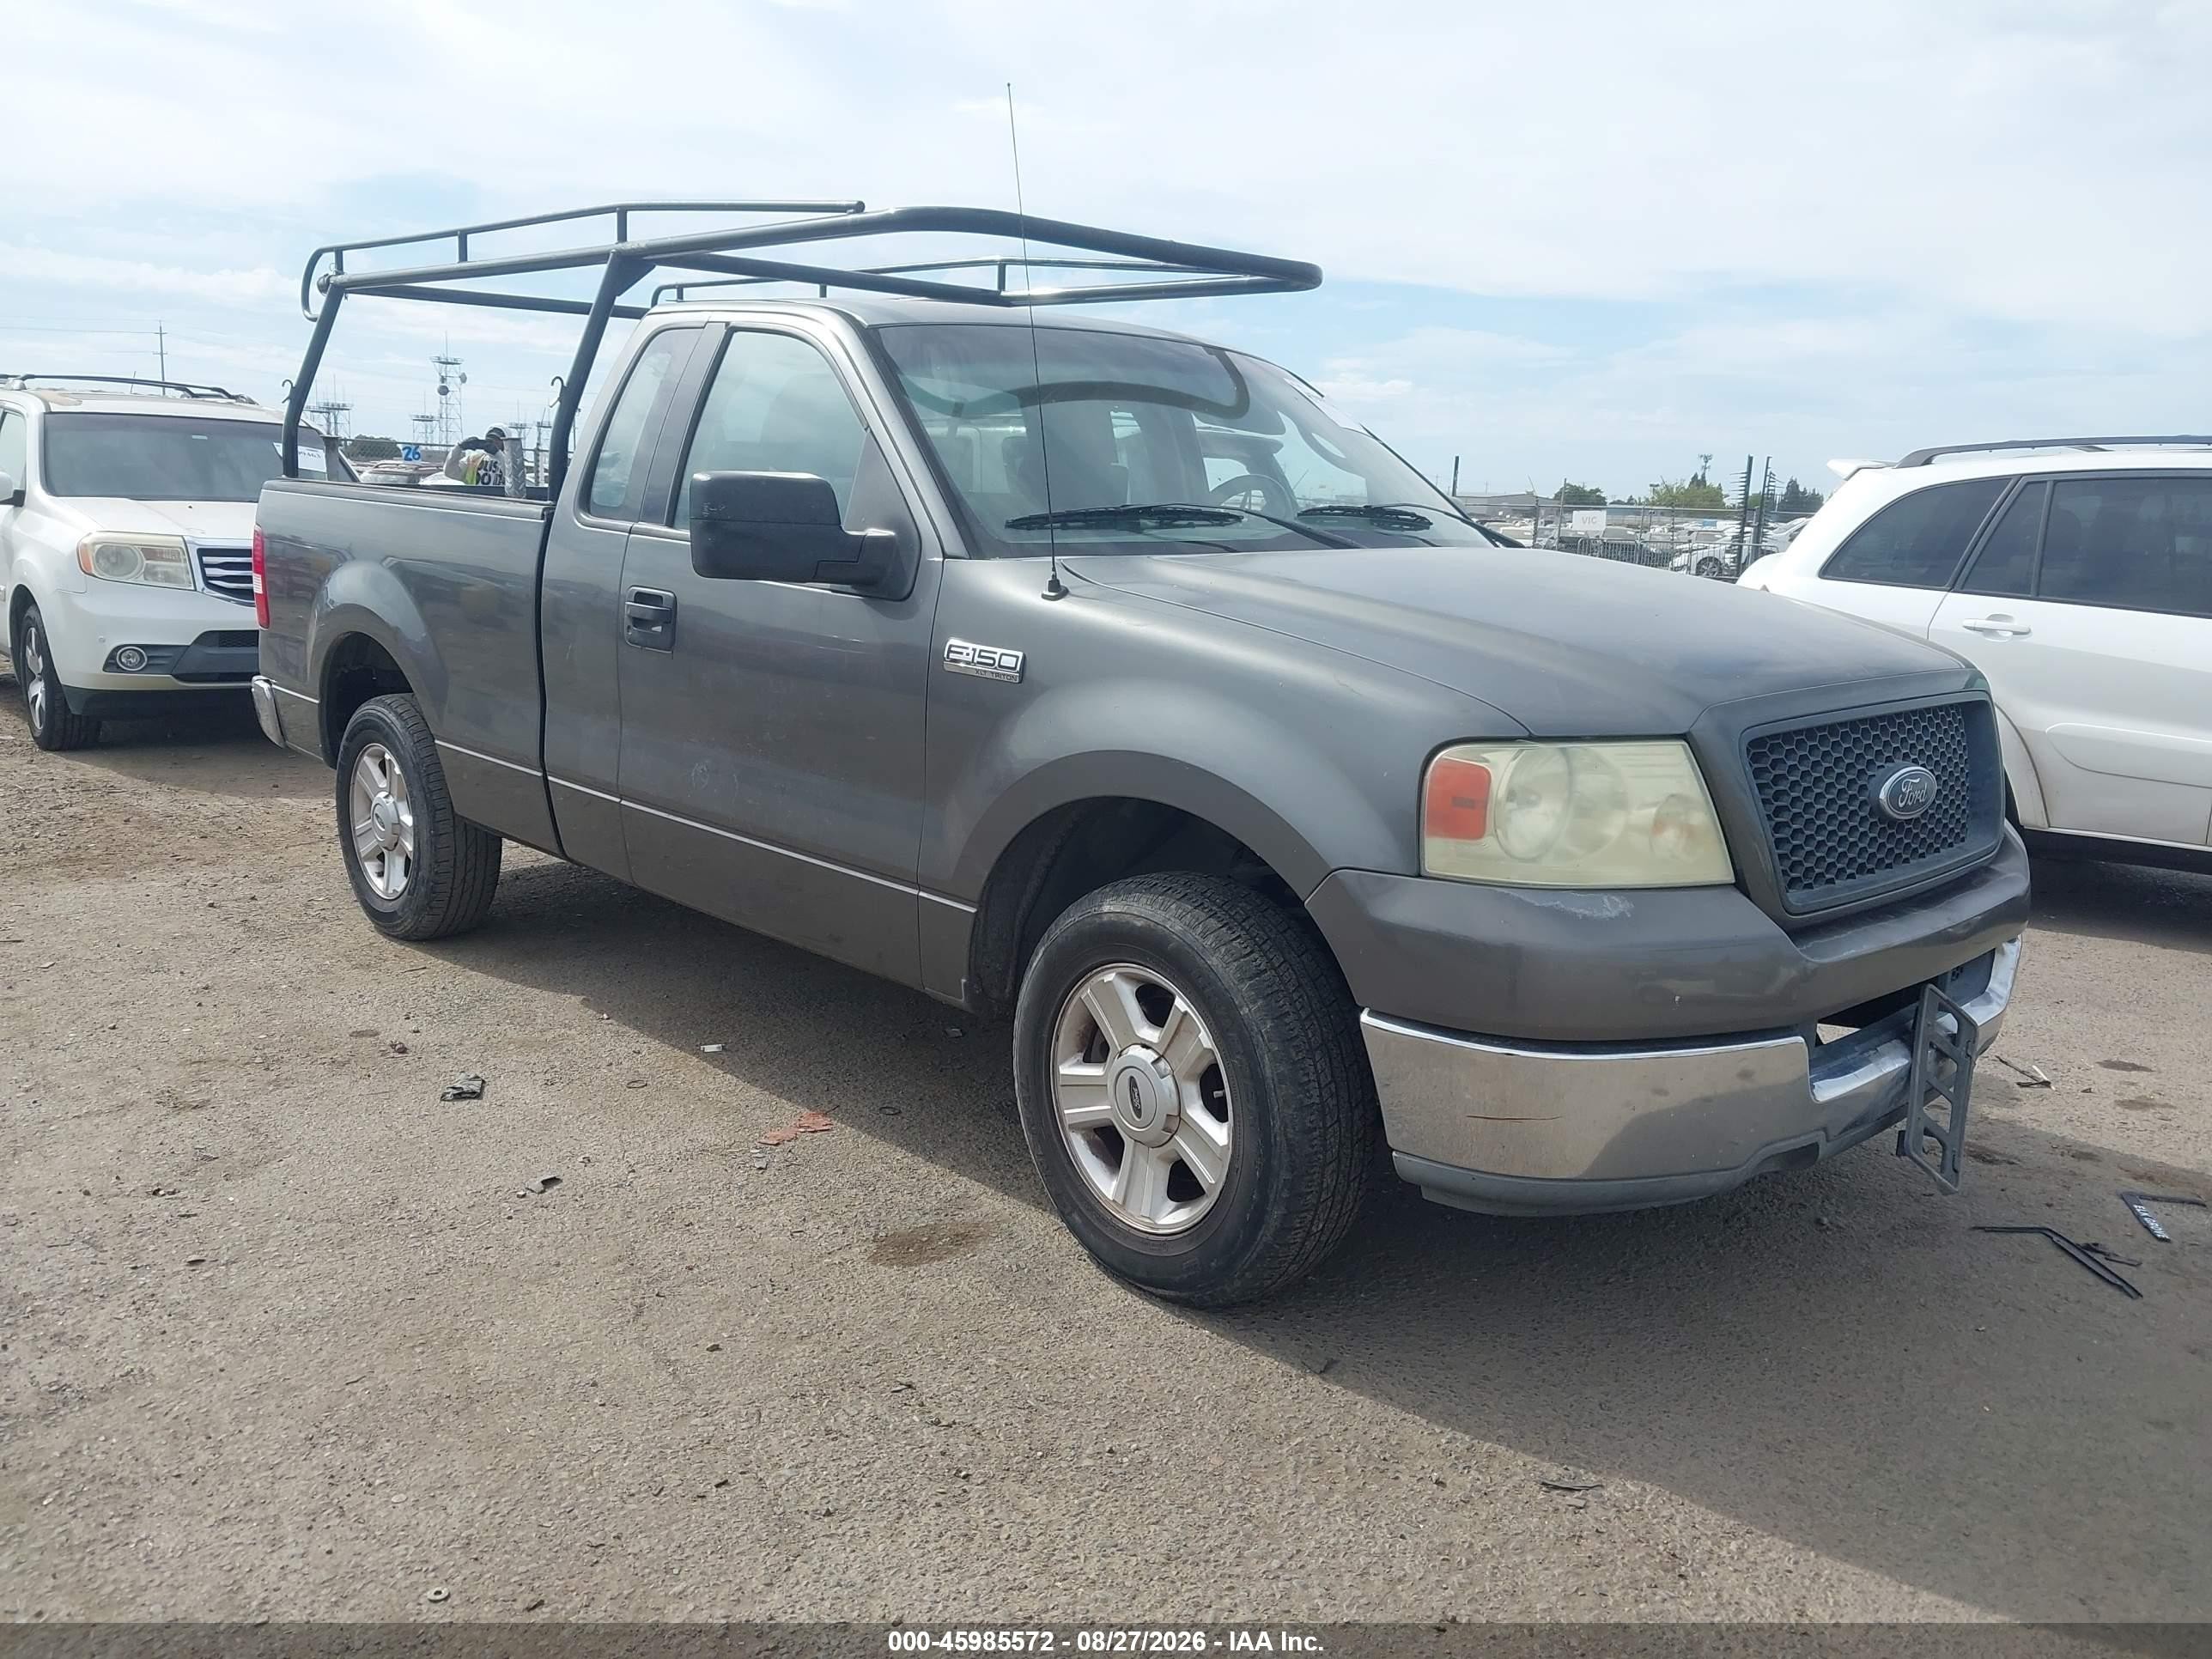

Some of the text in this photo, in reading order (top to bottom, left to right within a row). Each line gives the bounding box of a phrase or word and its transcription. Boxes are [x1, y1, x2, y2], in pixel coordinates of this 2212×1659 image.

[402, 446, 421, 461] 26
[1582, 516, 1597, 525] VIC
[990, 672, 1018, 682] TRITON
[1898, 777, 1928, 808] Ford
[1133, 1086, 1141, 1109] Ford
[2133, 1204, 2171, 1239] ELK GROVE
